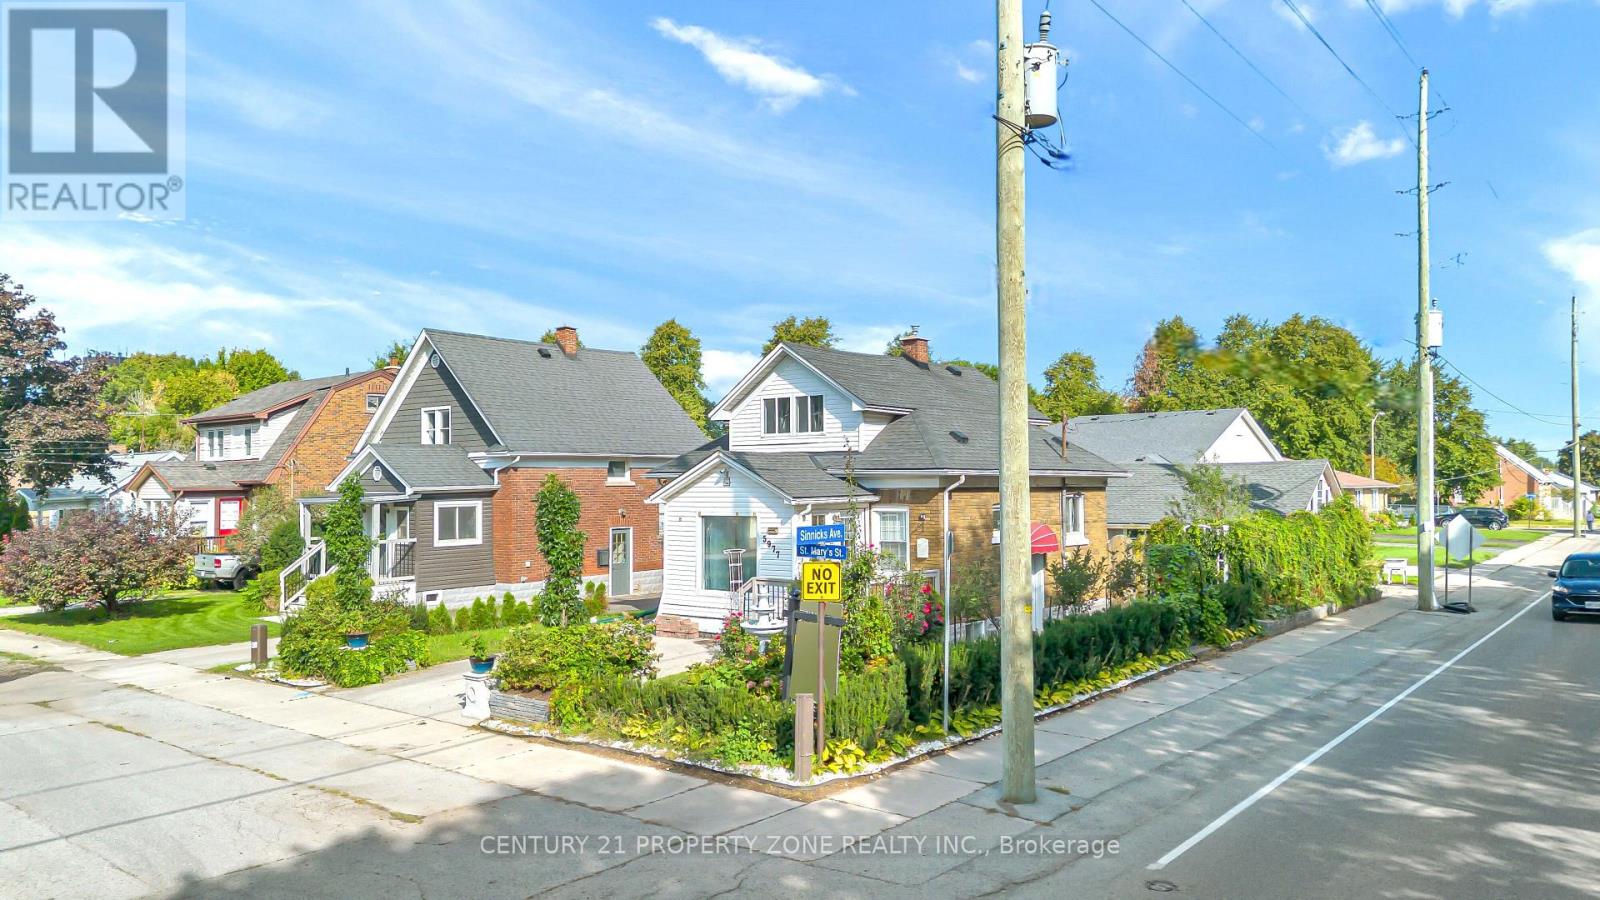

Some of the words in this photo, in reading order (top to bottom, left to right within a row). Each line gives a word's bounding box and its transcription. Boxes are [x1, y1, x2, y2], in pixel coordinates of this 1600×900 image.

[800, 530, 828, 541] Sinnicks
[829, 528, 843, 538] Ave.
[762, 535, 780, 559] 5977
[799, 546, 809, 555] St.
[811, 547, 833, 557] Mary's
[834, 548, 844, 557] St.
[812, 568, 832, 580] NO
[807, 582, 836, 594] EXIT
